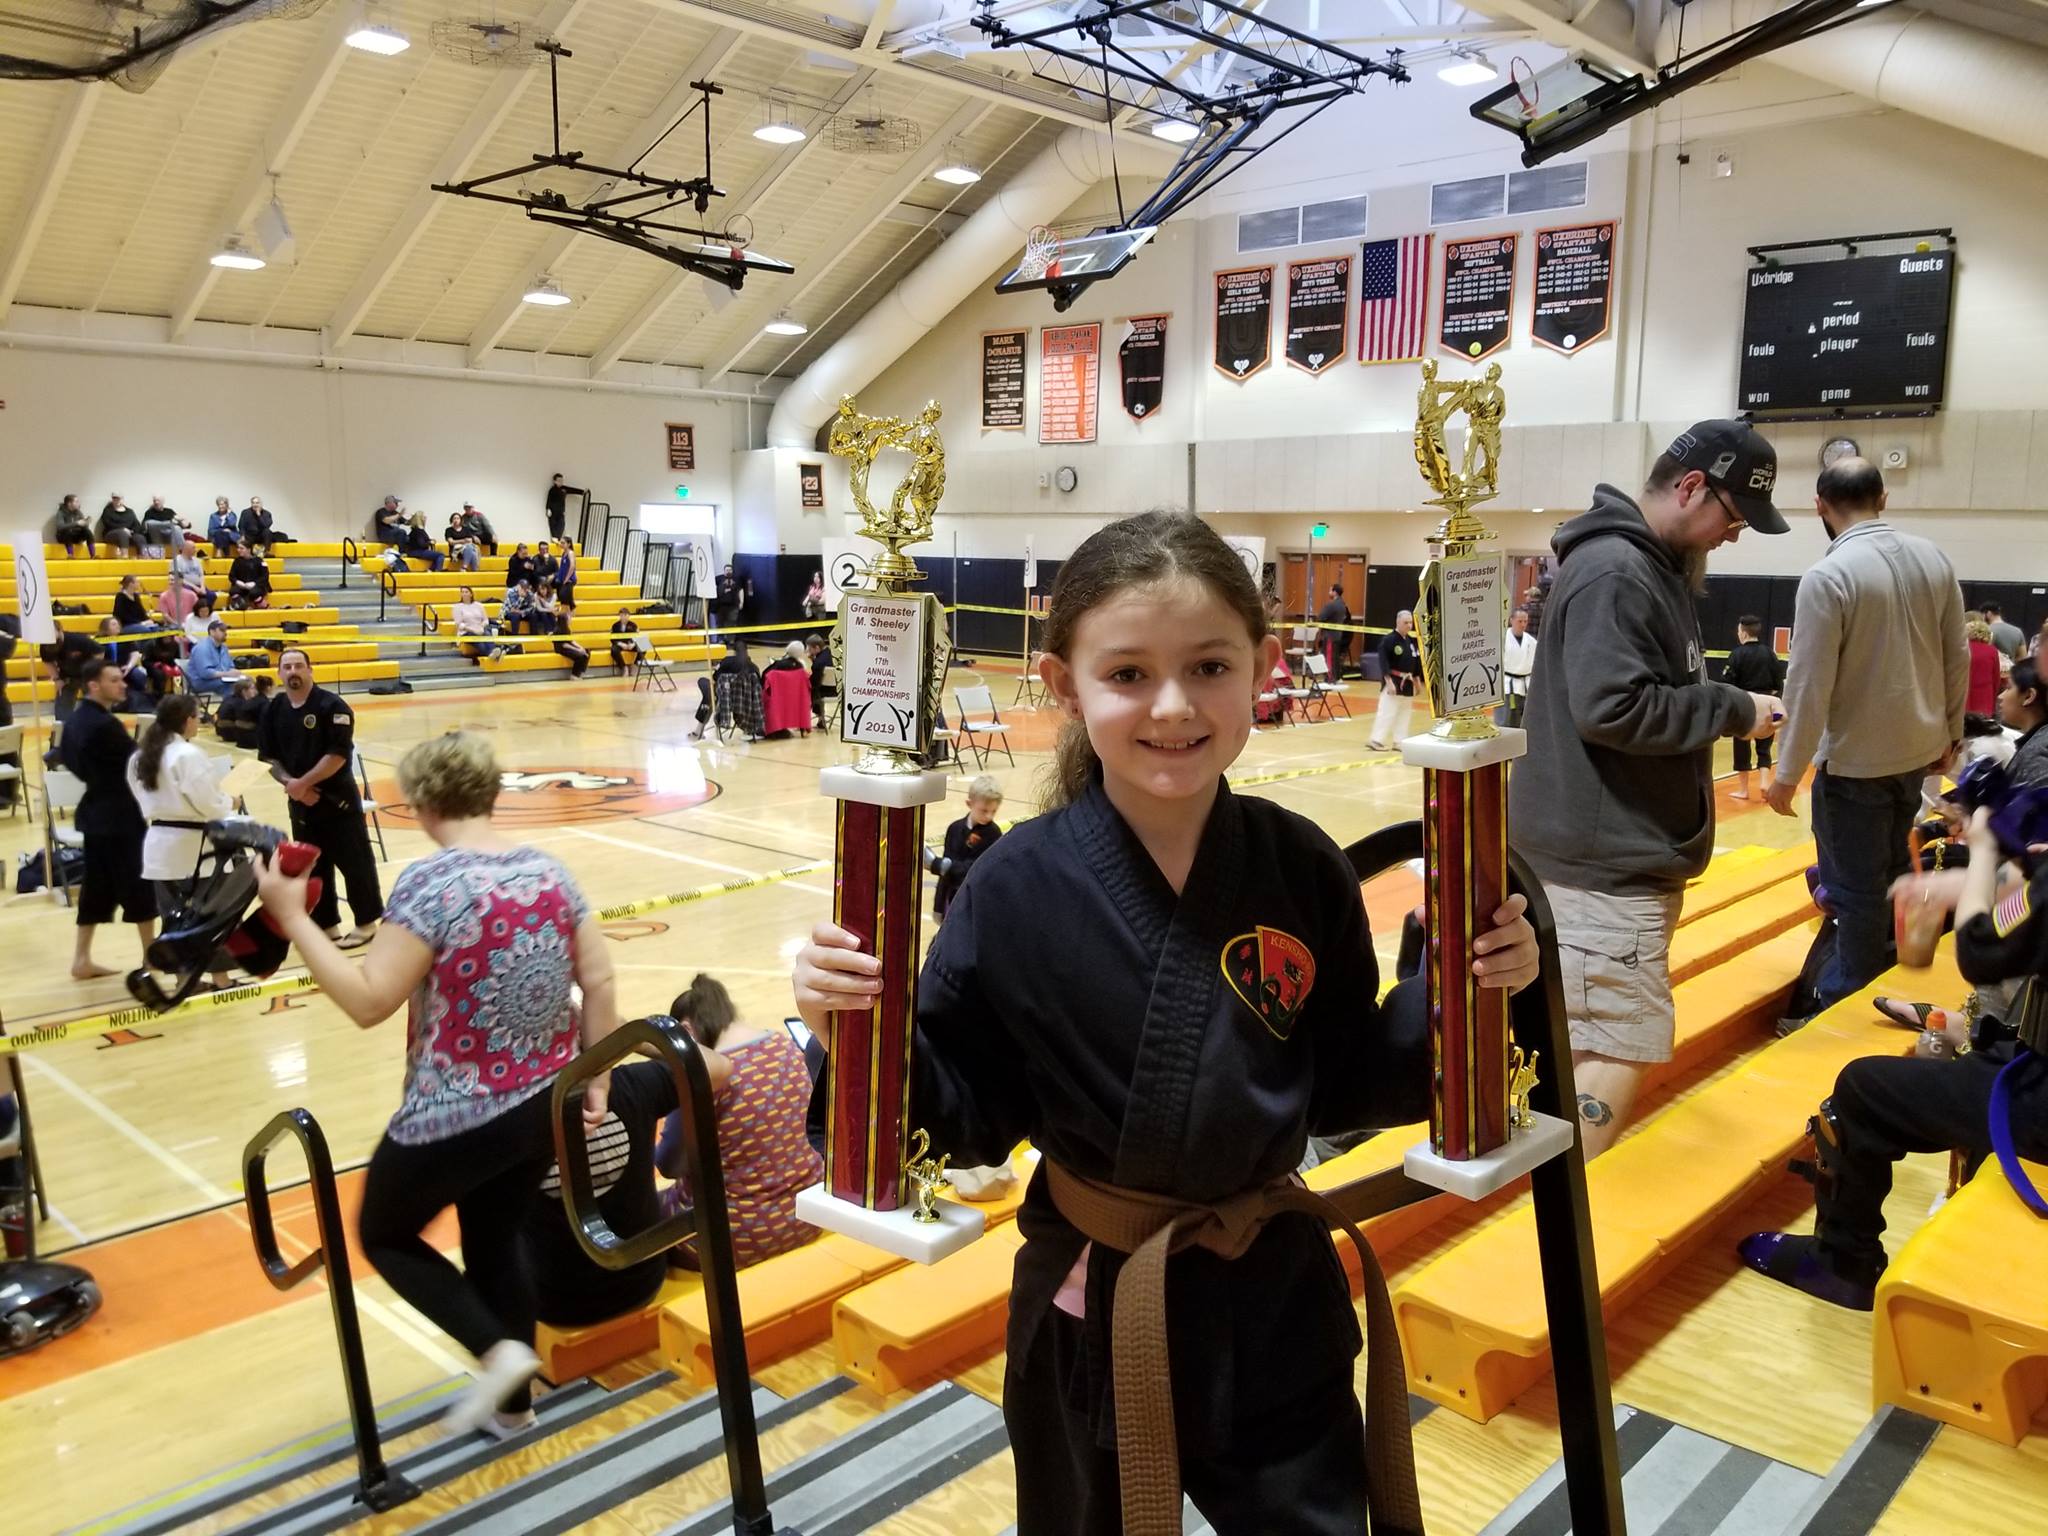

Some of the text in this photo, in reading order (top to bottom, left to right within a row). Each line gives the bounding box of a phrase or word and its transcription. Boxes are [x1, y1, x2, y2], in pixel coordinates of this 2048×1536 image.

[1557, 246, 1593, 256] BASEBALL
[1900, 258, 1944, 274] Guests
[1752, 271, 1794, 287] Uxbridge
[1823, 312, 1861, 330] period
[992, 336, 1015, 345] MARK
[1820, 337, 1860, 354] player
[1906, 332, 1936, 347] fouls
[1748, 344, 1775, 357] fouls
[1821, 388, 1851, 402] game
[1905, 384, 1929, 396] won
[1748, 392, 1770, 403] won
[672, 432, 689, 445] 113
[1752, 467, 1773, 478] WORLD
[841, 563, 859, 587] 2
[1446, 565, 1498, 581] Grandmaster
[1450, 578, 1494, 593] M. Sheeley
[1460, 594, 1484, 605] Presents
[850, 603, 916, 618] Grandmaster
[1468, 606, 1478, 614] The
[855, 616, 910, 632] M. Sheeley
[1467, 620, 1479, 628] 17th
[867, 632, 897, 642] Presents
[1462, 630, 1485, 640] ANNUAL
[876, 643, 888, 652] The
[1462, 639, 1485, 650] KARATE
[874, 657, 889, 666] 17th
[1450, 648, 1496, 664] CHAMPIONSHIPS
[866, 667, 896, 678] ANNUAL
[866, 677, 896, 688] KARATE
[852, 686, 910, 700] CHAMPIONSHIPS
[1463, 683, 1486, 697] 2019
[865, 721, 895, 734] 2019
[600, 904, 637, 920] CAUTION
[10, 1024, 67, 1047] CUIDADO
[1929, 1041, 1943, 1054] G
